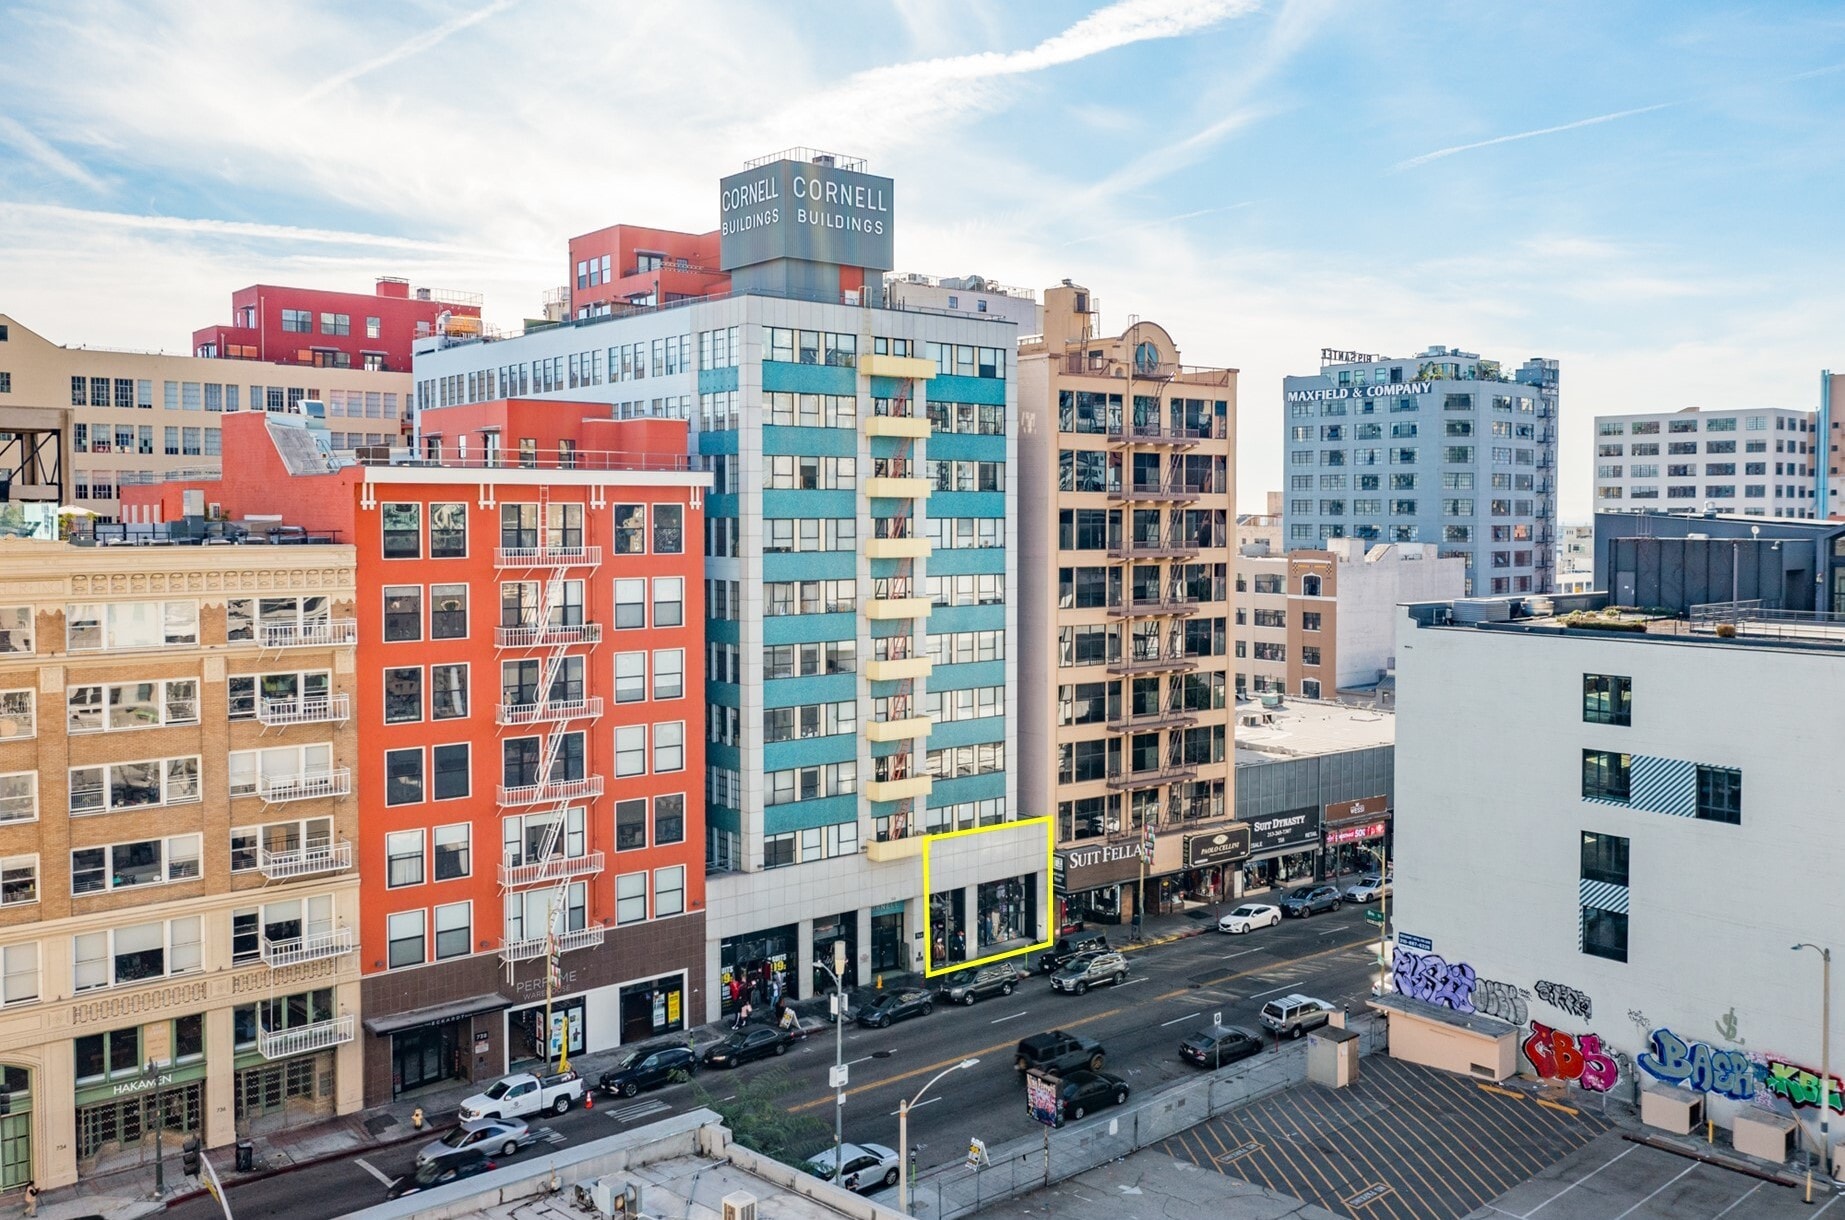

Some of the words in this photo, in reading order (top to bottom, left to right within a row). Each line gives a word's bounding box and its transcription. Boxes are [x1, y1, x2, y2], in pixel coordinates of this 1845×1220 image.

[722, 176, 779, 212] CORNELL
[793, 176, 887, 211] CORNELL
[722, 208, 779, 236] BUILDINGS
[797, 208, 883, 235] BUILDINGS
[1288, 388, 1348, 402] MAXFIELD
[1352, 388, 1362, 397] &
[1367, 382, 1431, 397] COMPANY
[1254, 821, 1272, 832] SUIT
[1272, 814, 1306, 829] DYNASTY
[1069, 851, 1101, 869] SUIT
[1637, 1027, 1755, 1101] BAER
